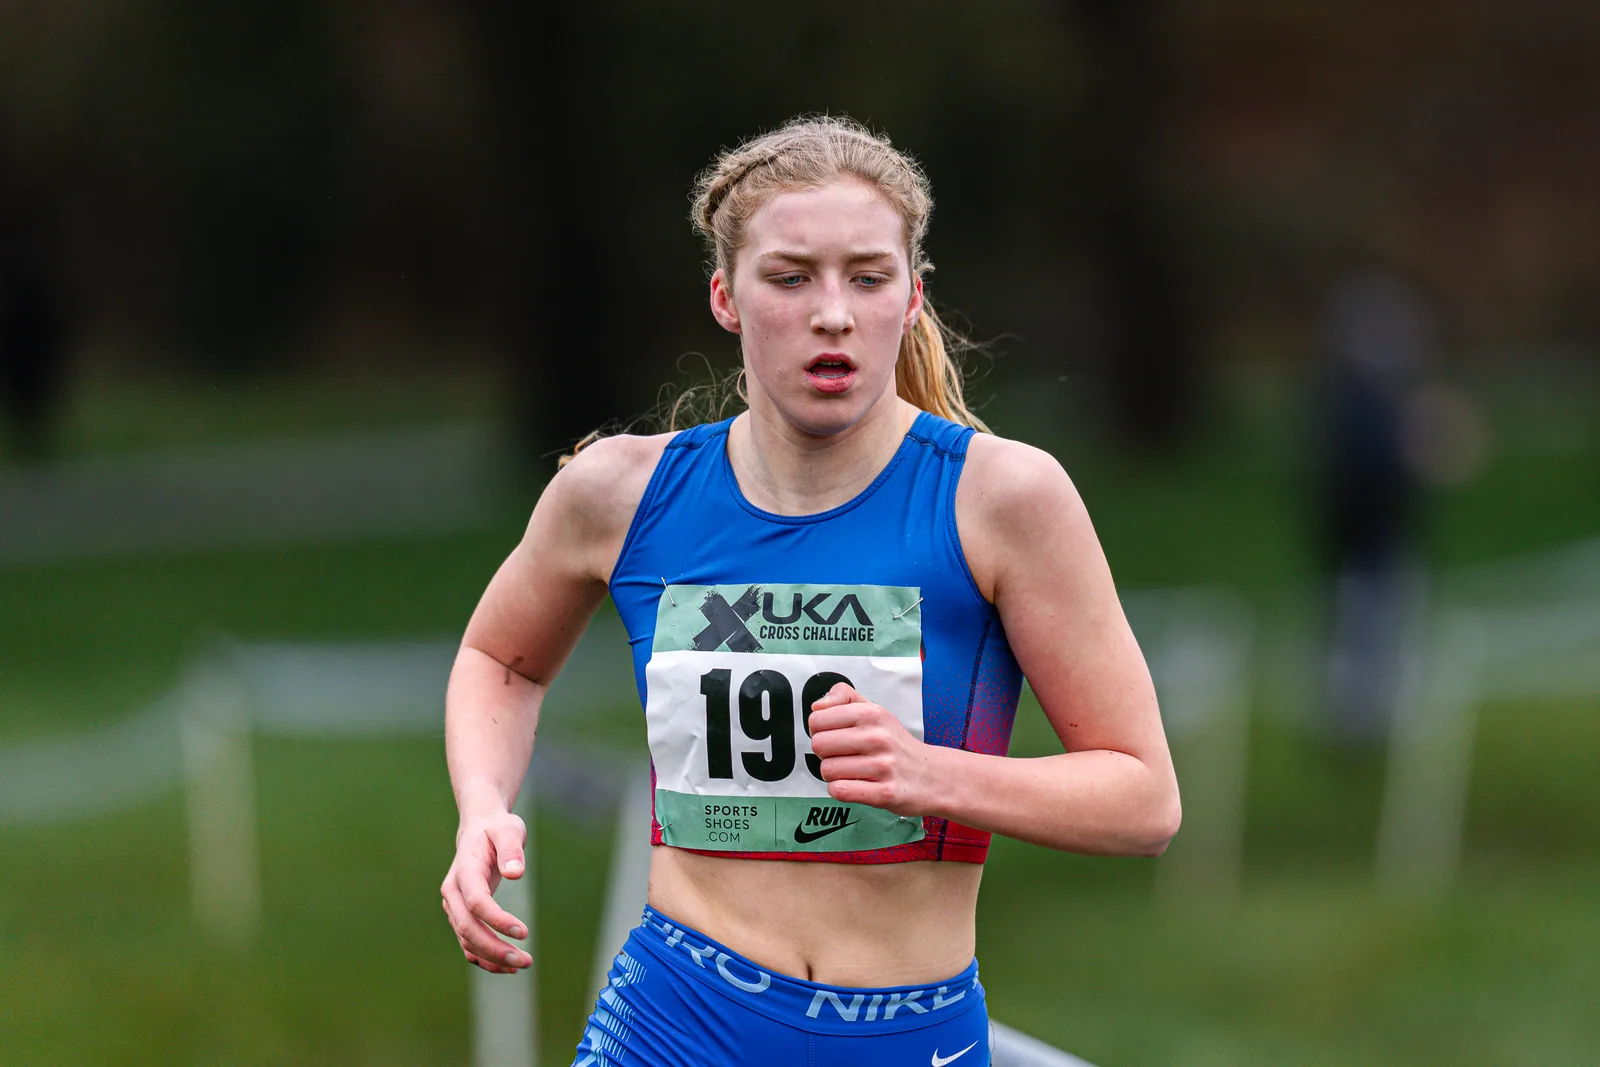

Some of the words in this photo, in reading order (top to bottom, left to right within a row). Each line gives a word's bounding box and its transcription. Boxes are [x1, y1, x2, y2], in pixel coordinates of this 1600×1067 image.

[762, 592, 874, 626] UKA
[760, 625, 800, 640] CROSS
[803, 626, 874, 642] CHALLENGE
[704, 805, 758, 817] SPORTS
[805, 806, 851, 826] RUN
[705, 818, 750, 830] SHOES
[705, 831, 740, 843] .COM
